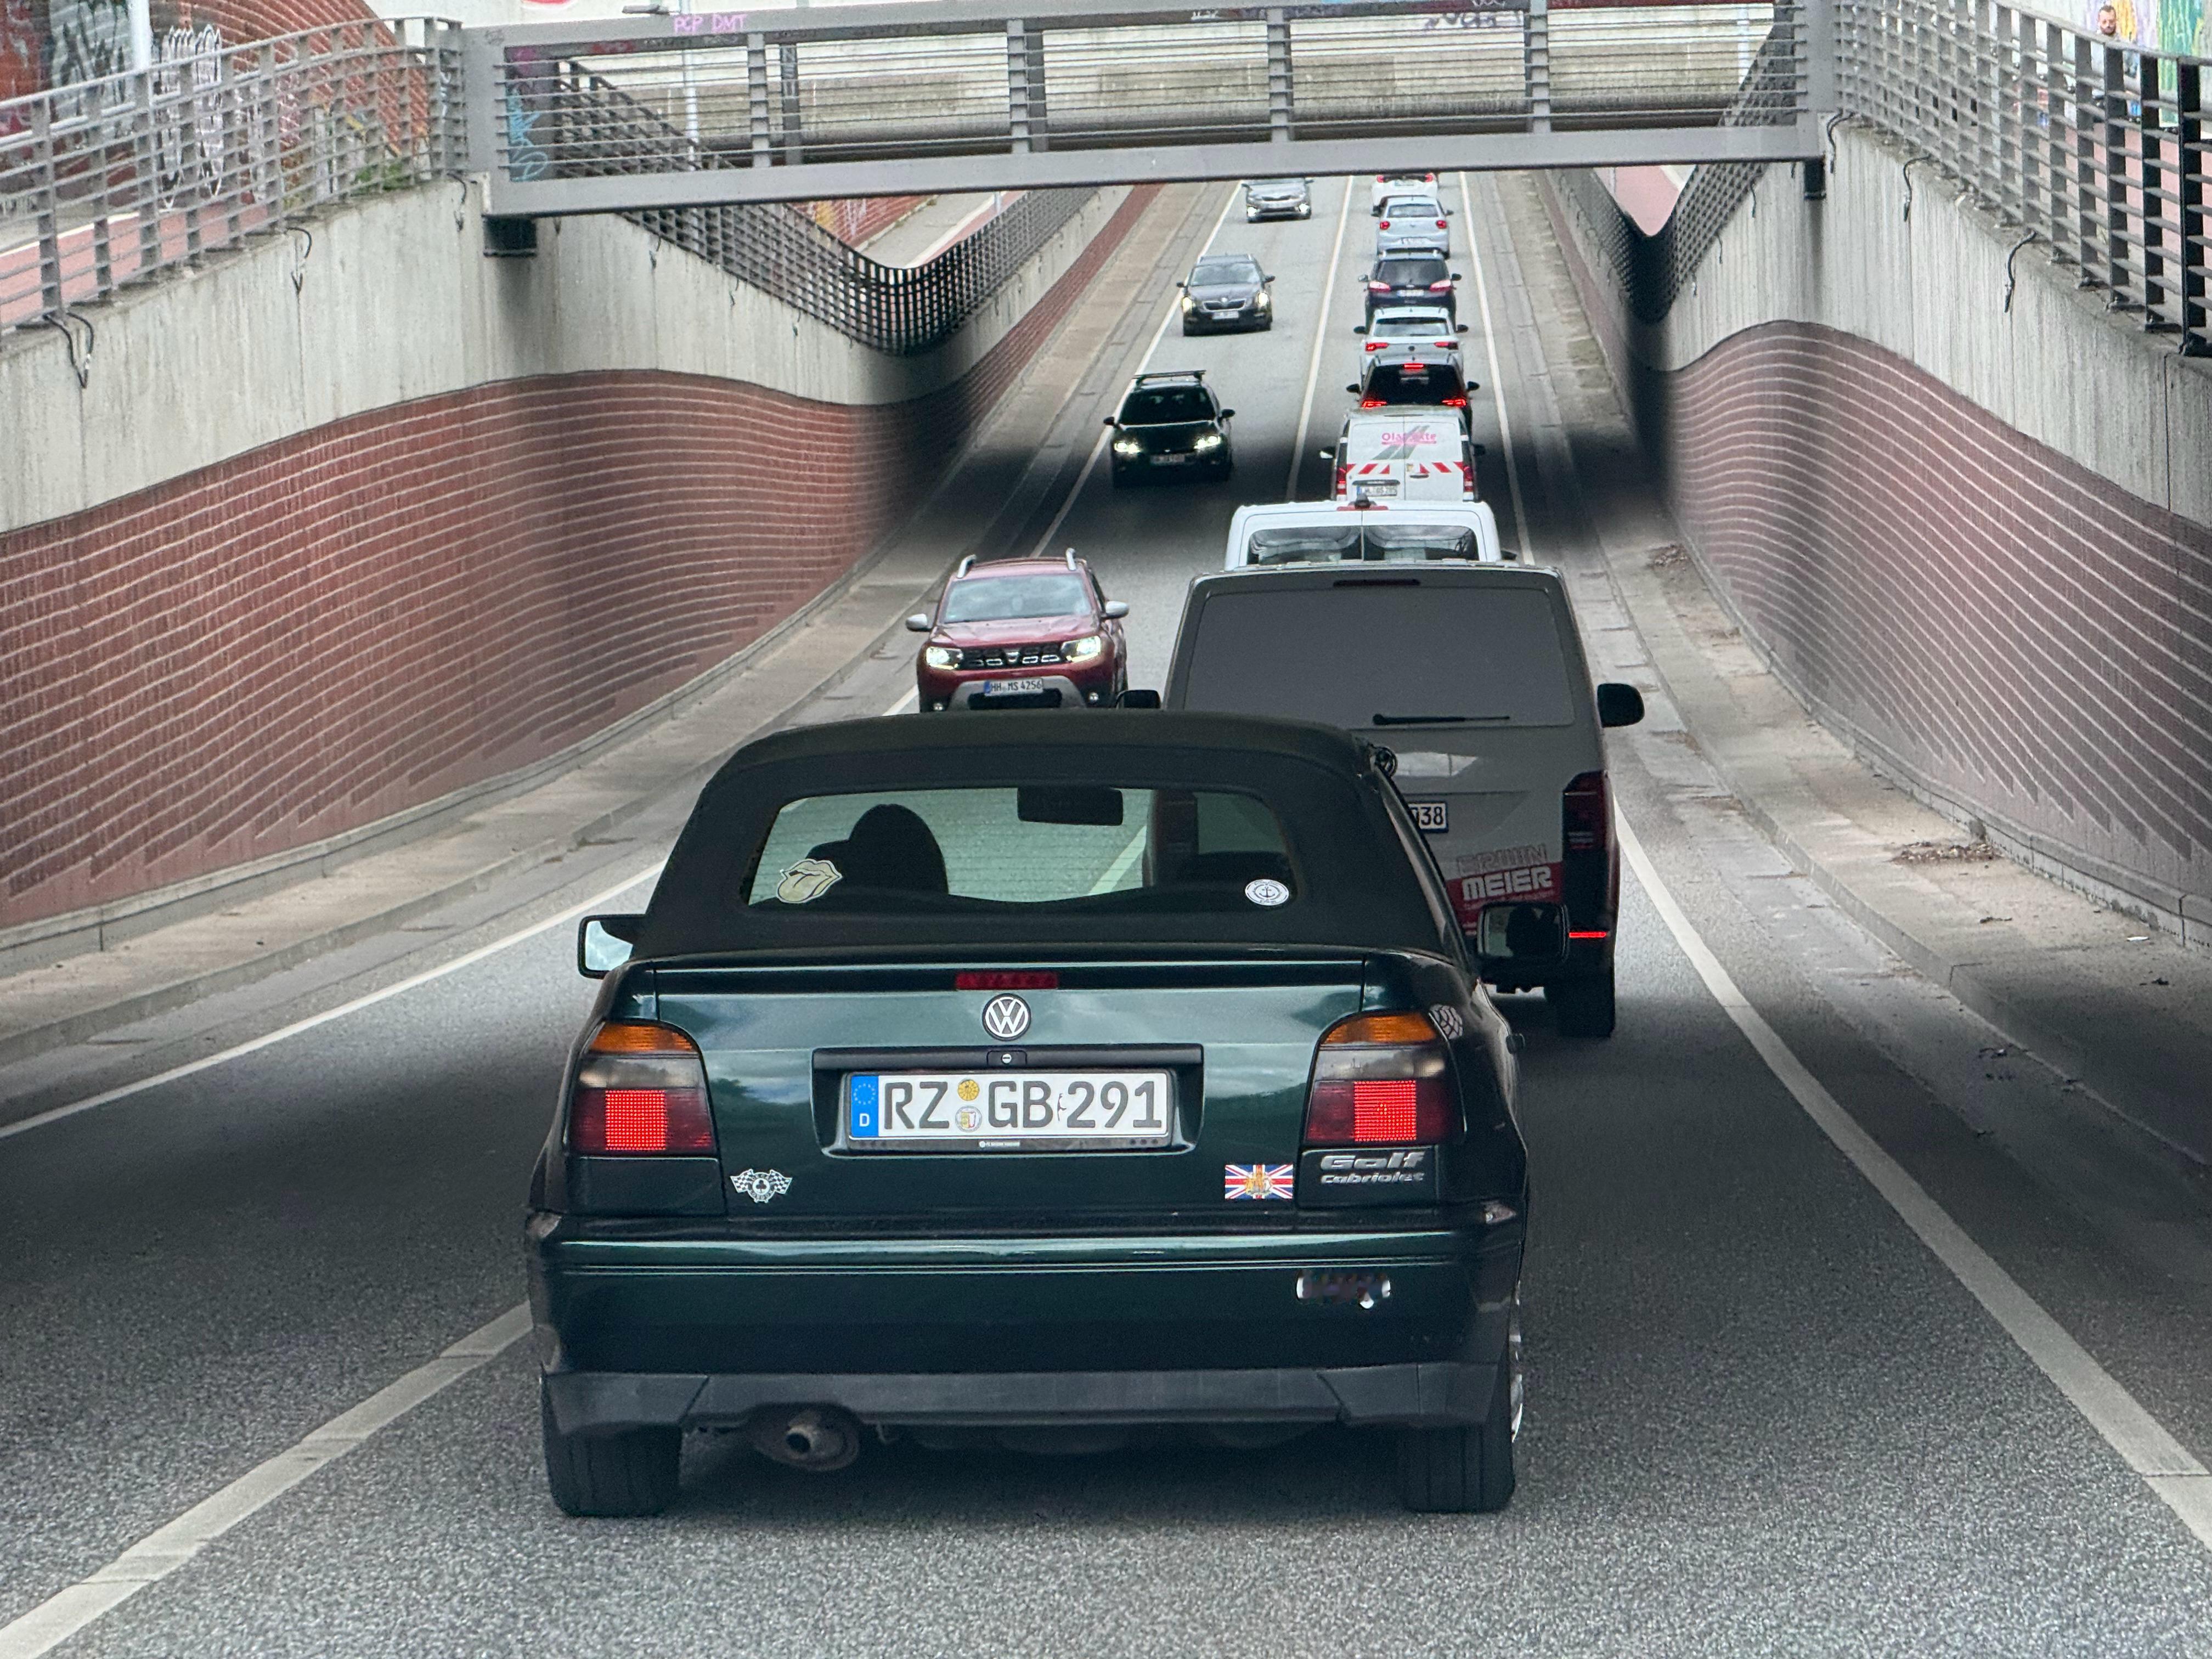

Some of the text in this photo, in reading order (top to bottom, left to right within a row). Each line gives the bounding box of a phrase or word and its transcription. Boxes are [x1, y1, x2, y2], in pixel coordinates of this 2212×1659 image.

[991, 680, 1041, 691] HH MS 4256
[1462, 866, 1553, 900] MEIER
[884, 1080, 1161, 1130] RZ GB 291
[859, 1113, 870, 1127] D
[1321, 1152, 1425, 1170] Golf
[1321, 1171, 1425, 1184] Cabriolet
